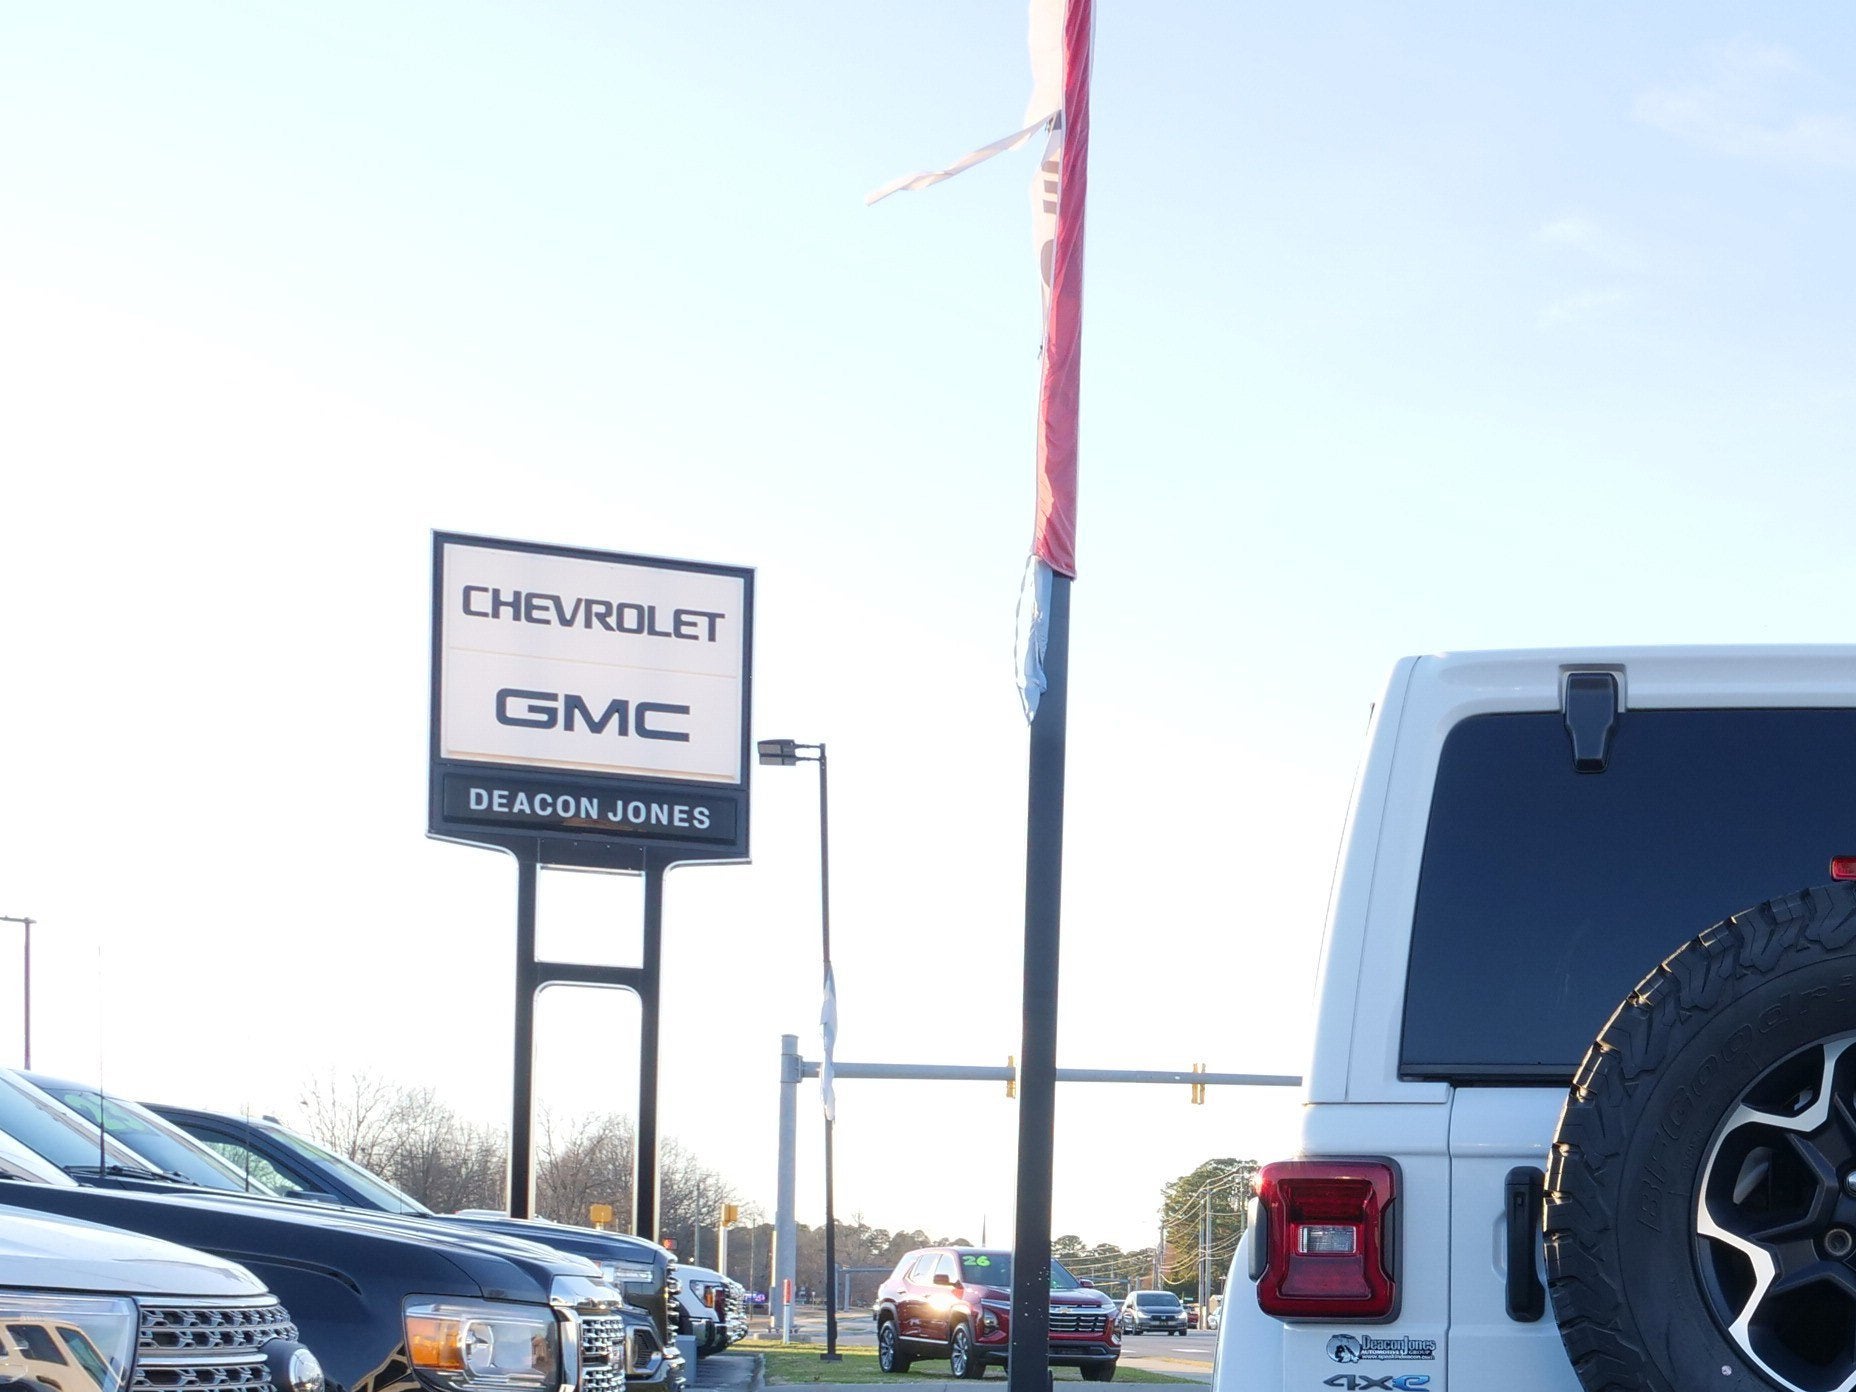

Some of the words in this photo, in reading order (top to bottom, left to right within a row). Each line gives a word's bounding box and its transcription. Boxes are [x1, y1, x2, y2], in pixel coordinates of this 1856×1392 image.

[462, 585, 726, 642] CHEVROLET
[495, 688, 690, 743] GMC
[469, 787, 599, 819] DEACON
[607, 800, 711, 829] JONES
[962, 1255, 992, 1267] 26
